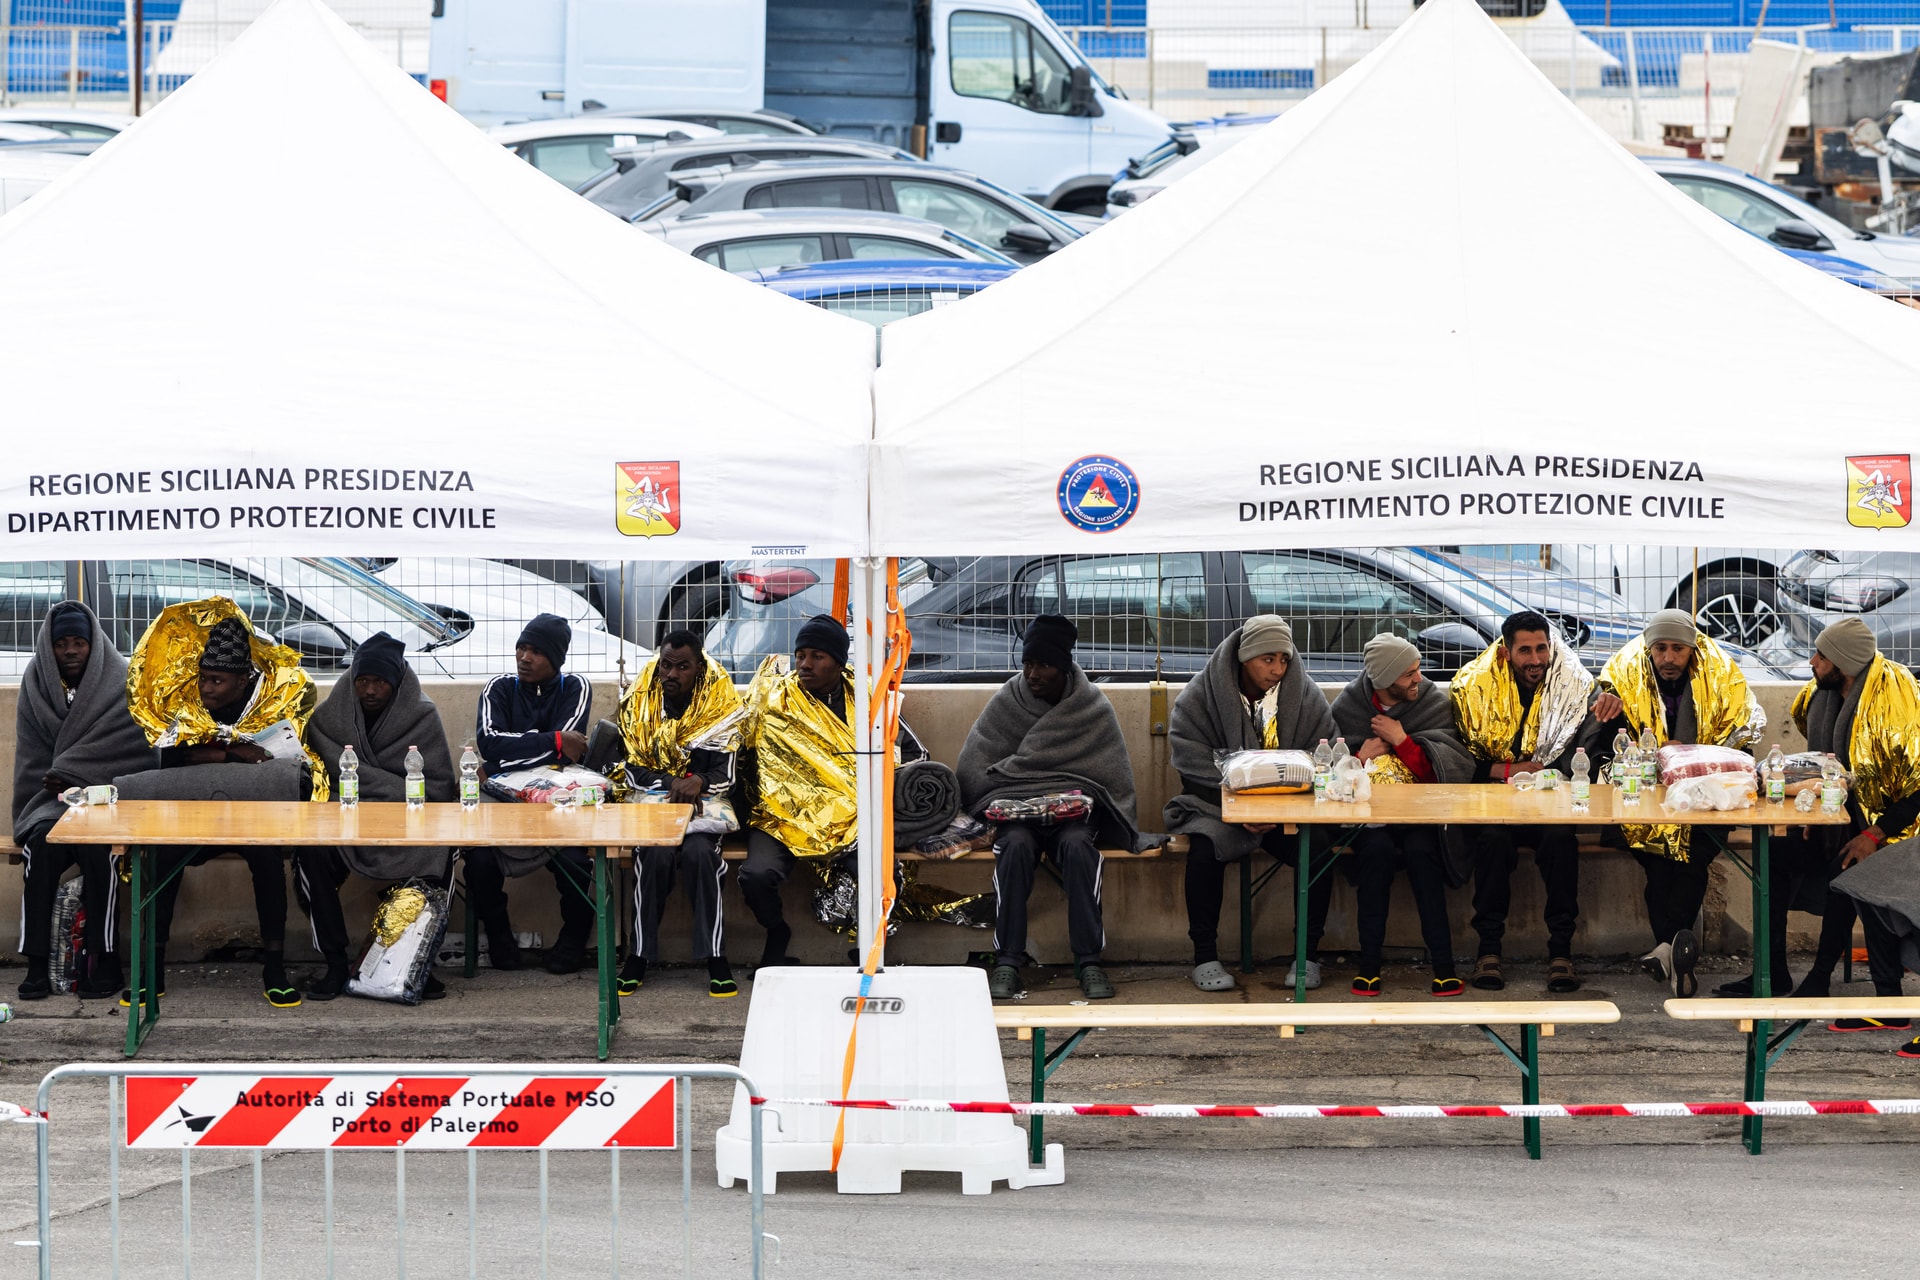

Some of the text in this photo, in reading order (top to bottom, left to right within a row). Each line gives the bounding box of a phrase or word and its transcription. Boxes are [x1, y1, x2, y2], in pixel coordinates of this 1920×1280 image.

[1072, 467, 1126, 487] PROTEZIONE CIVILE
[1260, 454, 1705, 486] REGIONE SICILIANA PRESIDENZA
[30, 467, 474, 497] REGIONE SICILIANA PRESIDENZA
[1073, 506, 1123, 521] REGIONE SICILIANA
[1239, 493, 1725, 522] DIPARTIMENTO PROTEZIONE CIVILE
[8, 505, 496, 534] DIPARTIMENTO PROTEZIONE CIVILE
[751, 548, 806, 556] MASTERTENT
[235, 1091, 615, 1107] Autorità di Sistema Portuale MSO
[332, 1117, 519, 1133] Porto di Palermo
